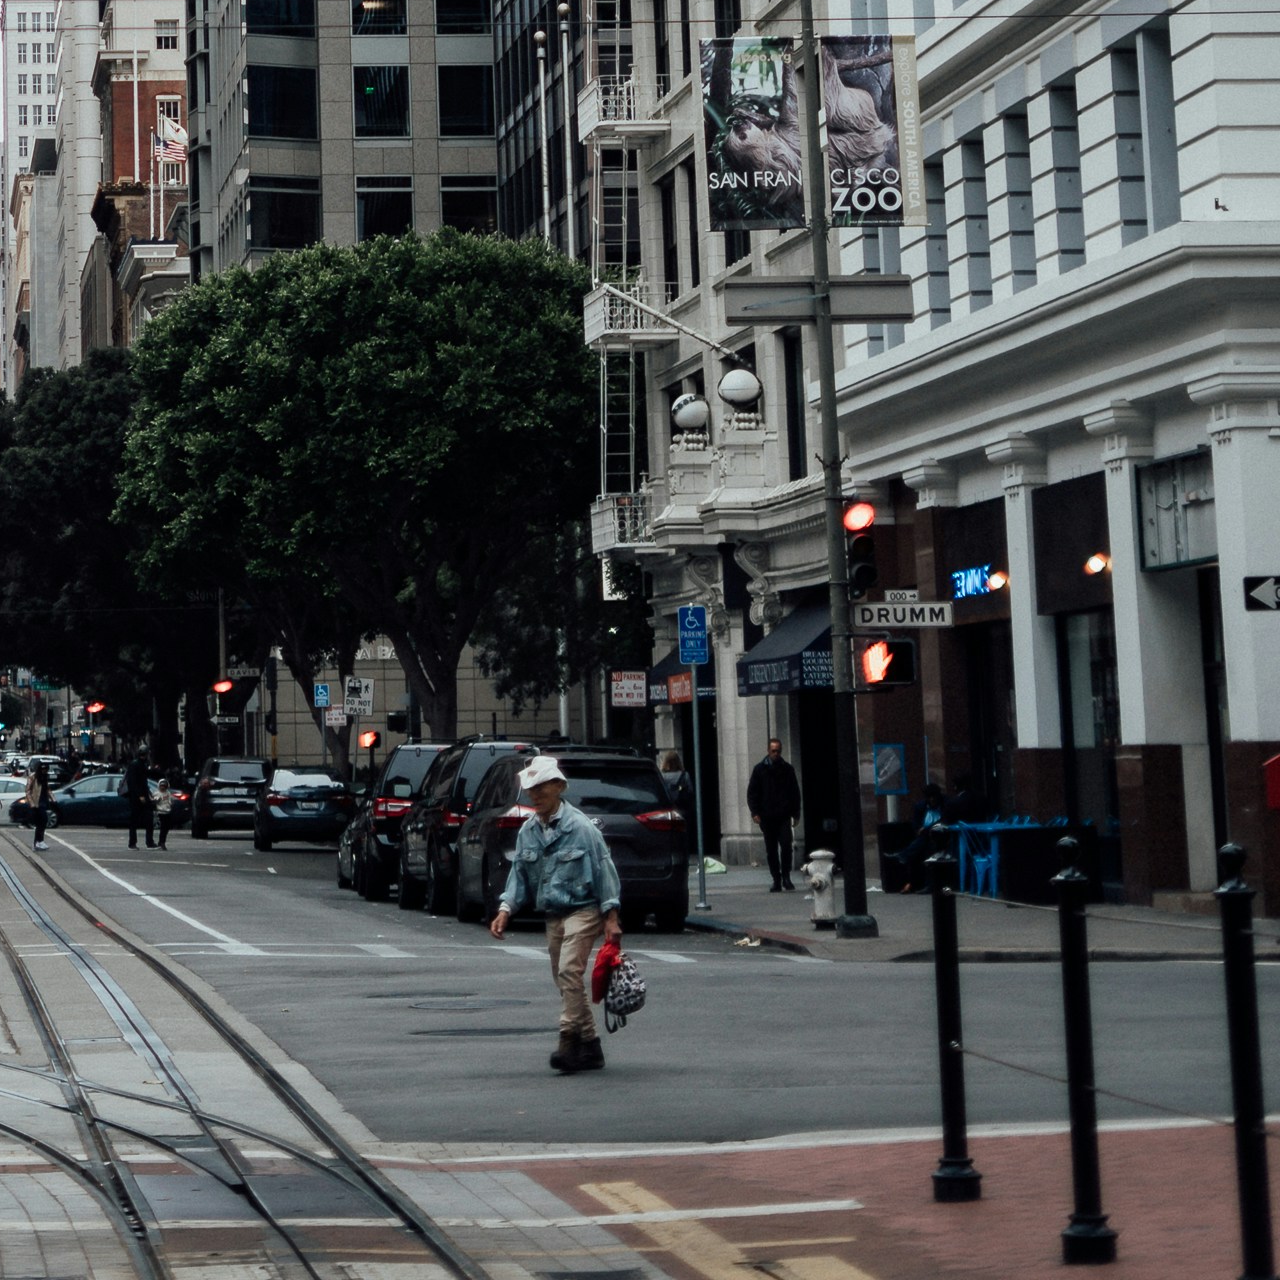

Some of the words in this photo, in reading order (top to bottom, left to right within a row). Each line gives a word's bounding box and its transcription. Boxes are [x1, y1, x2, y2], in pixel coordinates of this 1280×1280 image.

[899, 47, 911, 97] explore
[903, 99, 917, 146] SOUTH
[708, 171, 749, 189] SAN
[754, 170, 802, 187] FRAN
[830, 168, 900, 185] CISCO
[906, 149, 920, 209] AMERICA
[831, 187, 903, 212] ZOO
[889, 592, 907, 601] 000
[860, 606, 946, 624] DRUMM
[681, 630, 705, 639] PARKING
[685, 640, 701, 648] ONLY
[612, 671, 622, 681] NO
[623, 673, 645, 681] PARKING
[345, 698, 355, 706] DO
[348, 707, 367, 715] PASS
